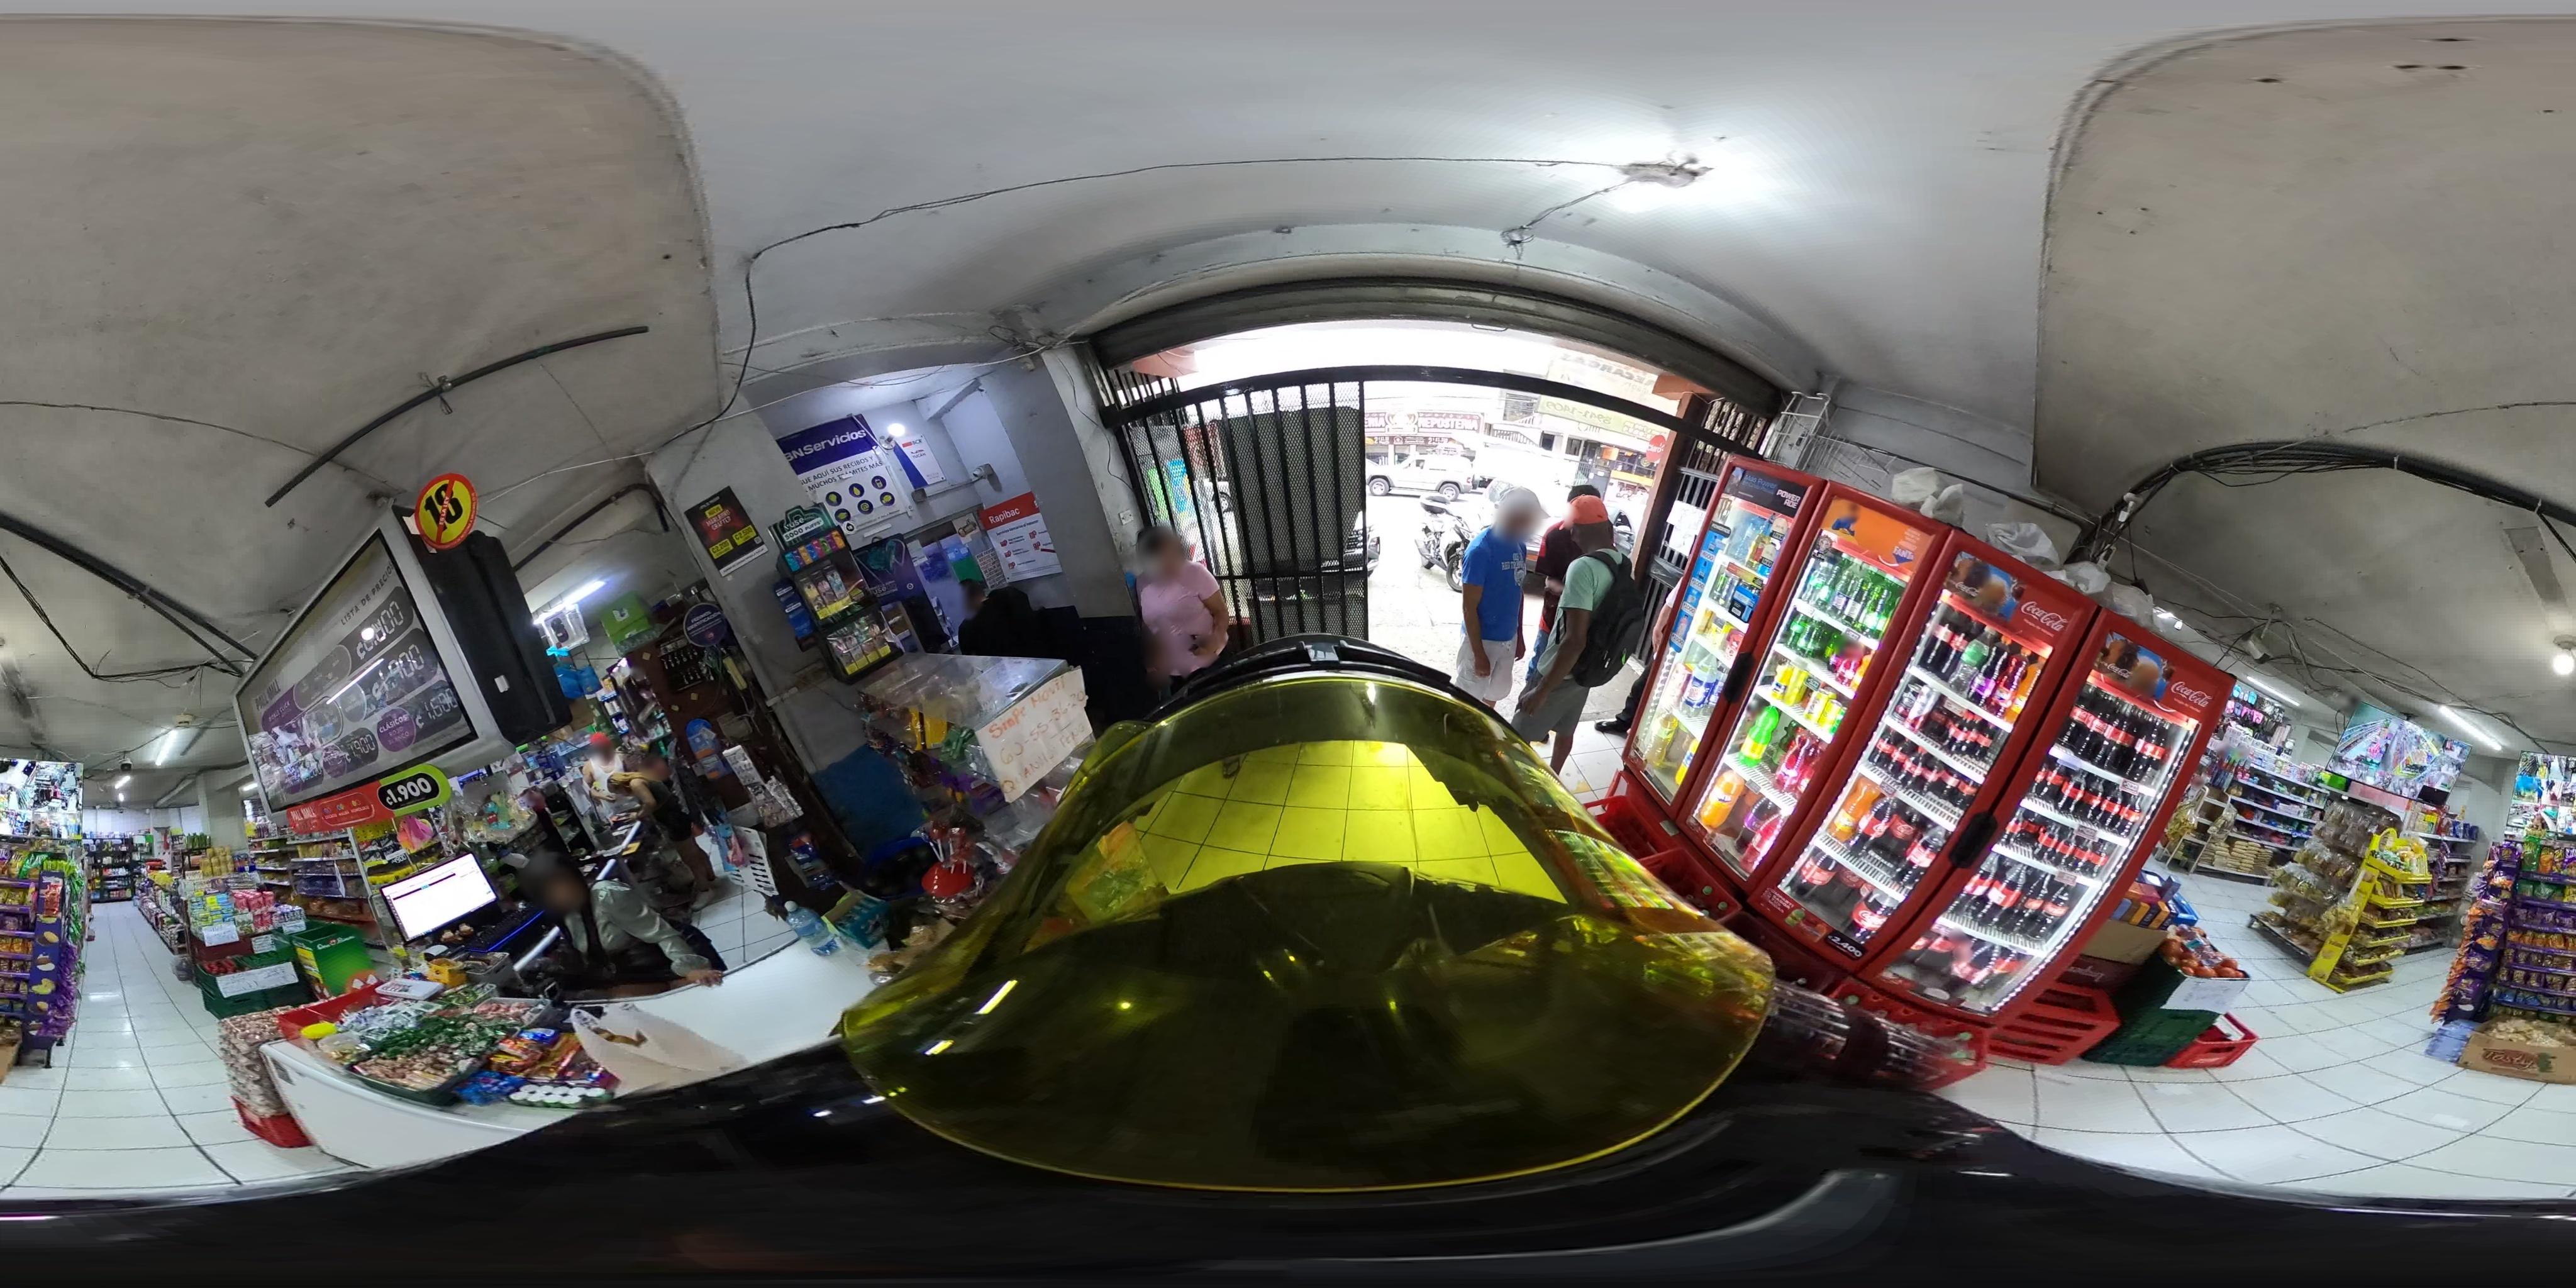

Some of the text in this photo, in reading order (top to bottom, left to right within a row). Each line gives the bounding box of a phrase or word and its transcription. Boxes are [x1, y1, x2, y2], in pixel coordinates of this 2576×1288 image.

[814, 469, 830, 482] AQUÍ
[830, 466, 842, 475] SUS
[843, 458, 869, 469] RECIBOS
[808, 477, 836, 492] MUCHOS
[1777, 489, 1801, 502] POWER
[989, 508, 1020, 524] Rapibac
[785, 528, 803, 540] 5000
[341, 561, 394, 626] LISTA DE PRECIOS
[379, 714, 409, 733] CLÁSICOS
